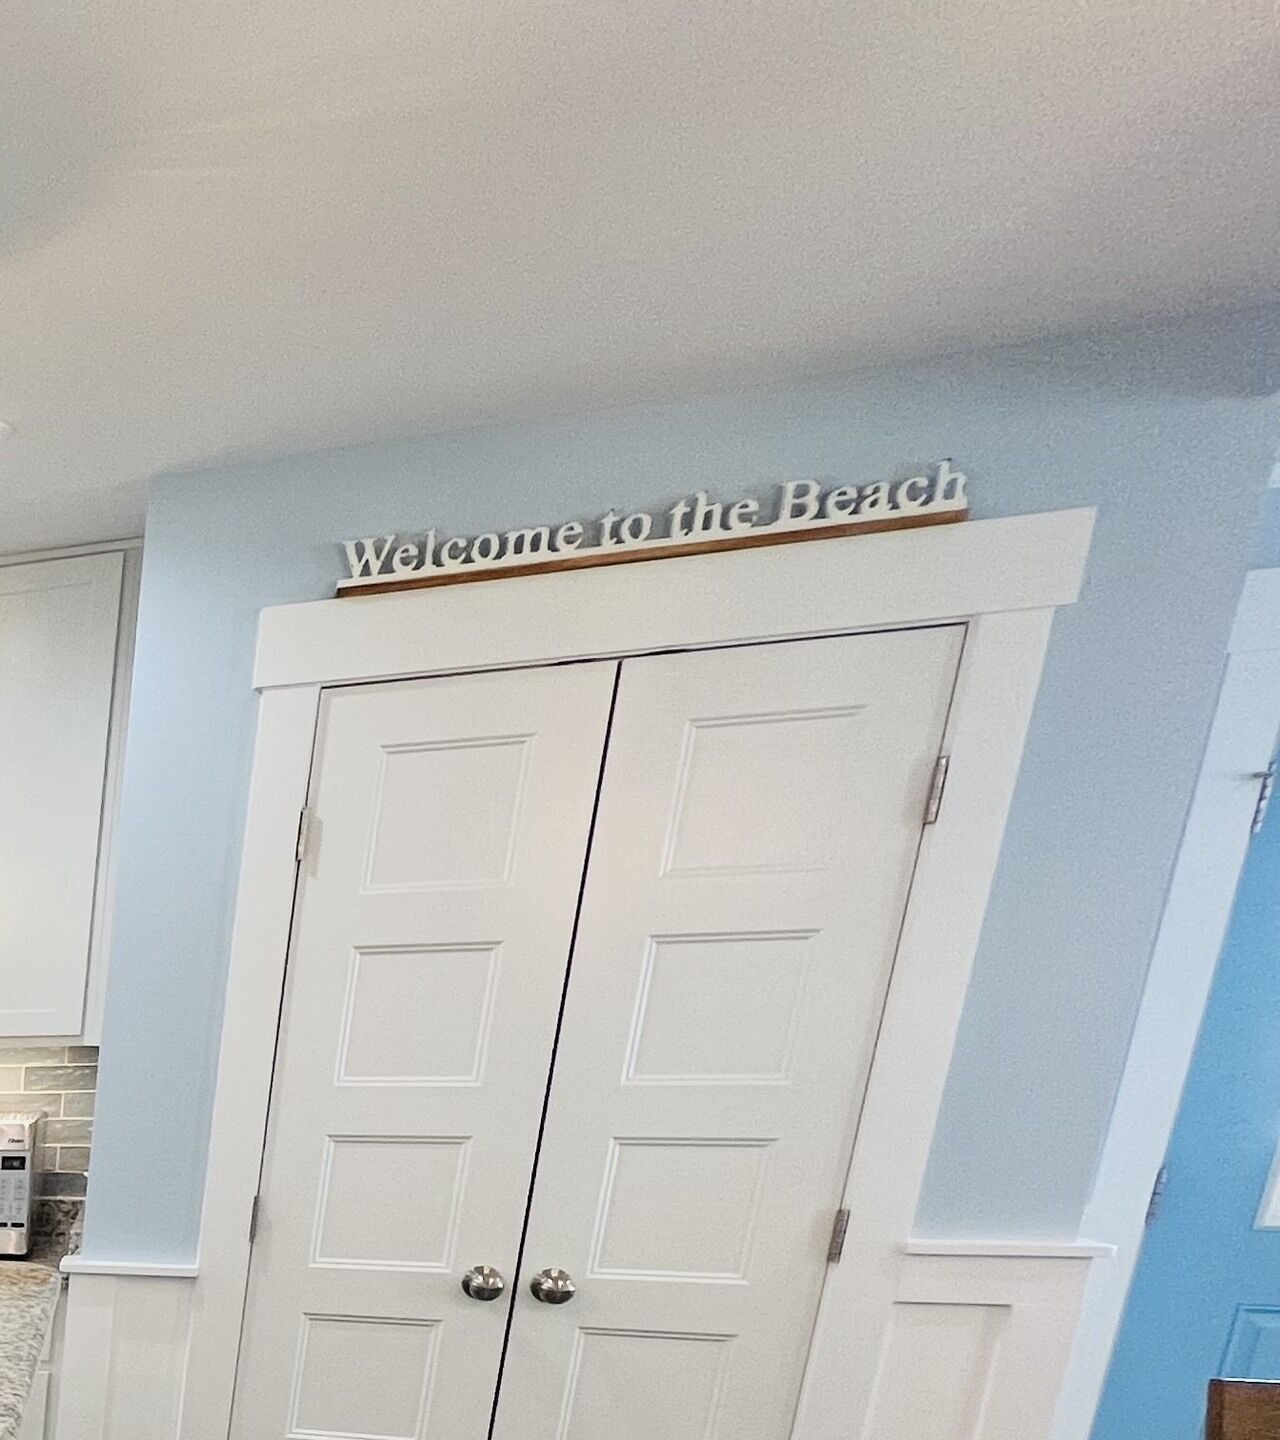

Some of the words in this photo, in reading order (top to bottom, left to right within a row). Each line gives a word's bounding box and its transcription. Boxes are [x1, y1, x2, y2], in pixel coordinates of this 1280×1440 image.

[343, 519, 584, 580] Welcome
[601, 508, 653, 547] to
[669, 490, 760, 539] the
[774, 458, 969, 521] Beach
